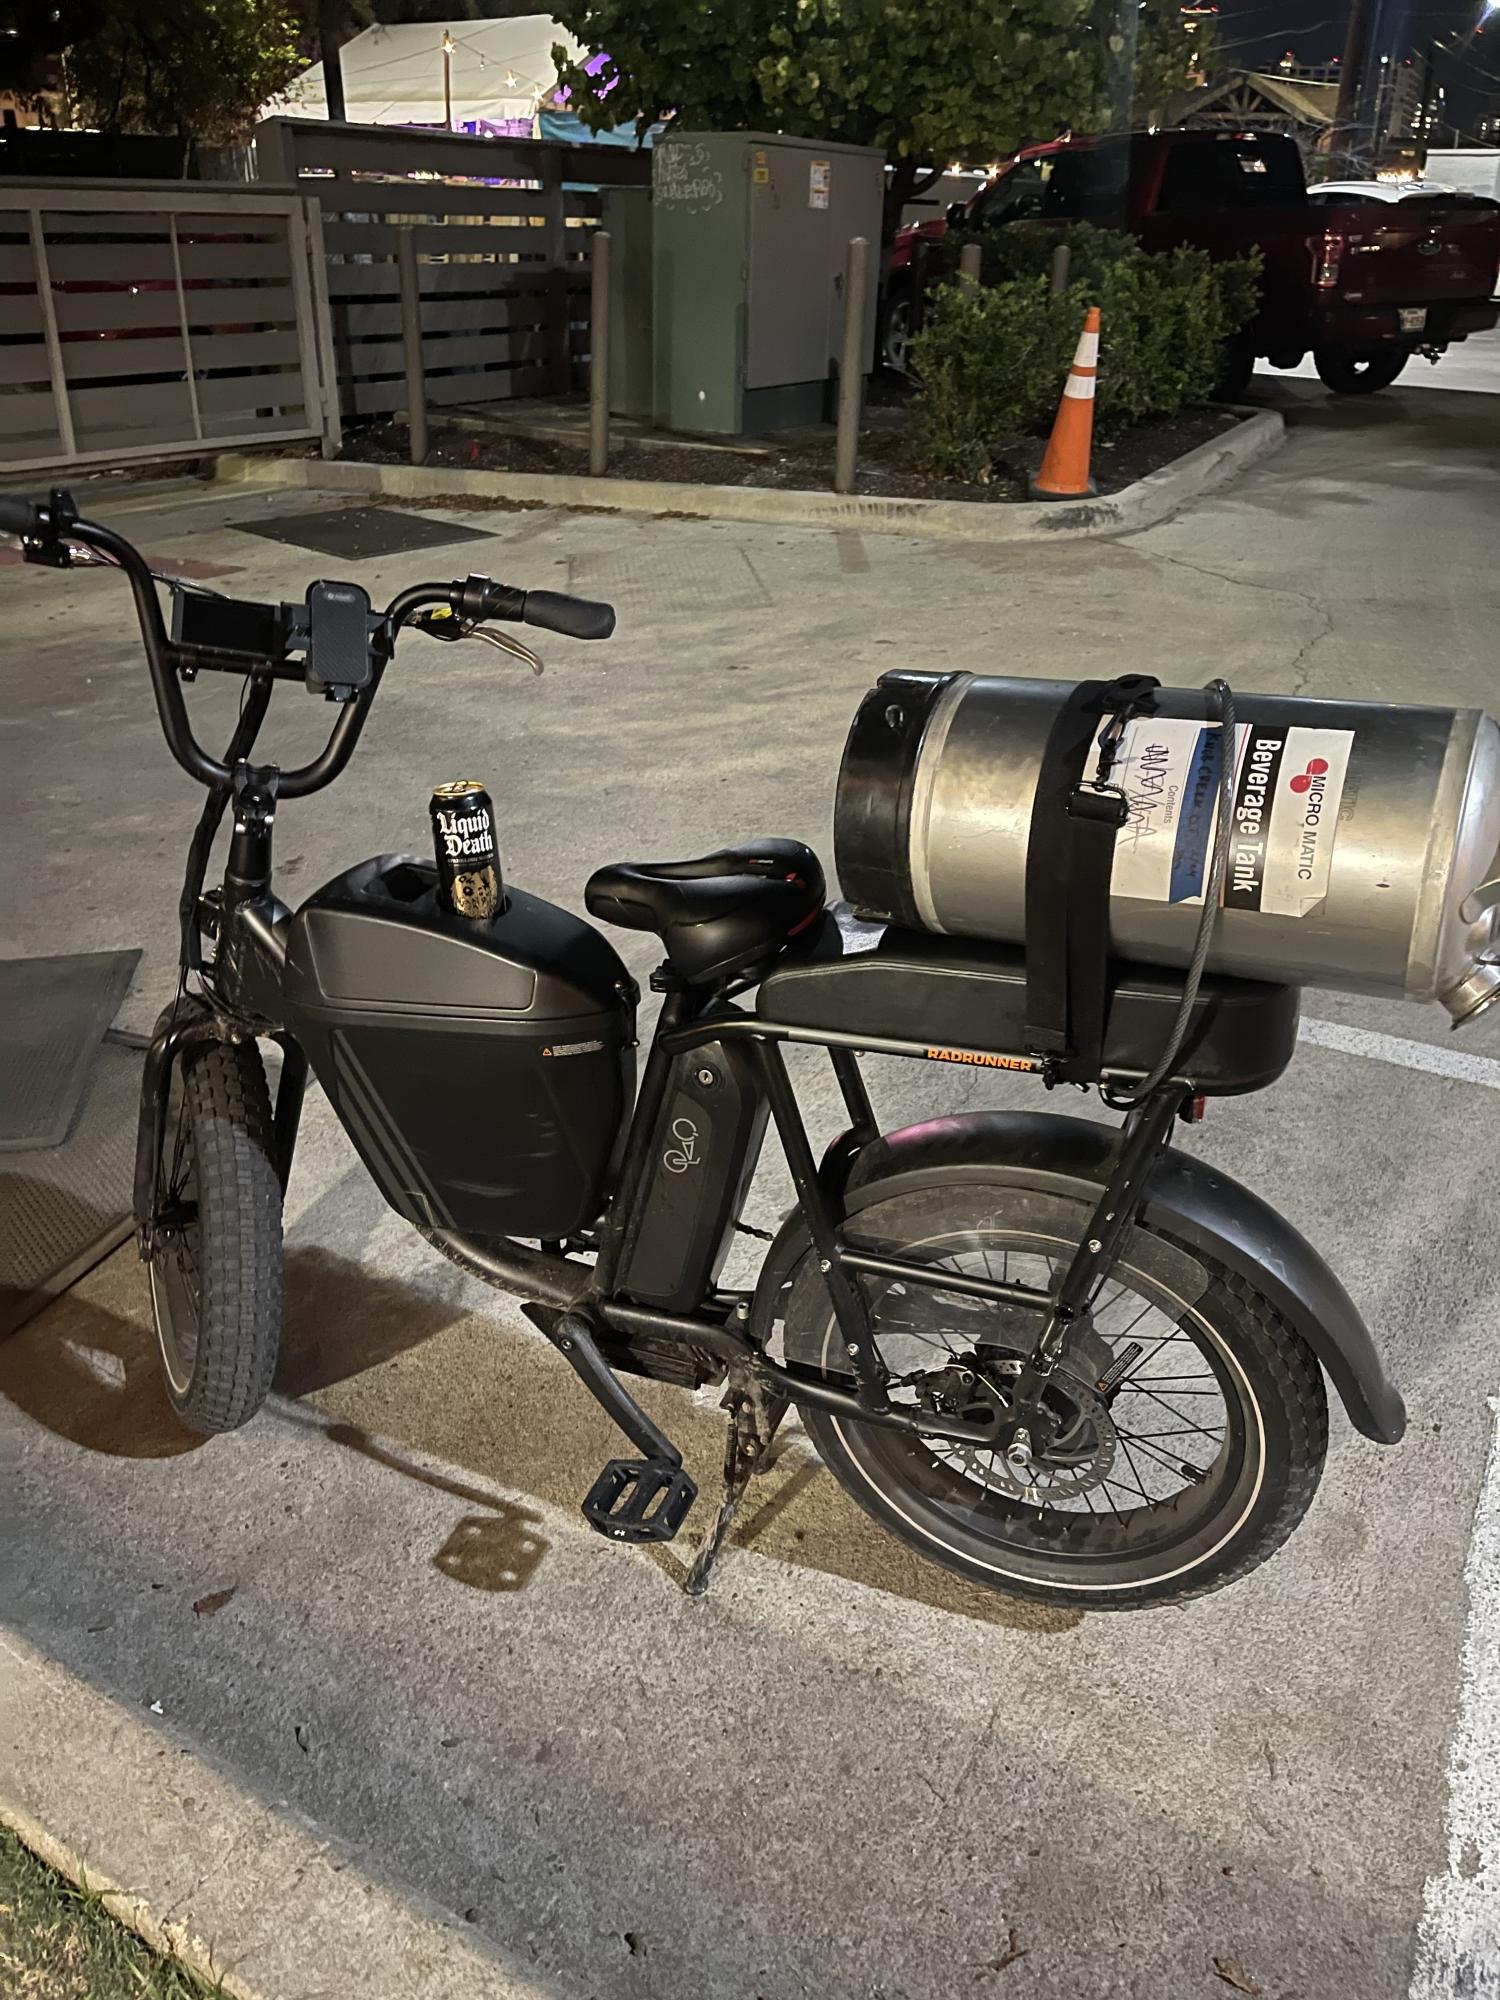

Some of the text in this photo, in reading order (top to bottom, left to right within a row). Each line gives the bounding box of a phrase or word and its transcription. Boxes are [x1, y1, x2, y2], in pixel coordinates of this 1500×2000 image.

[1163, 785, 1179, 824] Contents
[1232, 739, 1283, 893] Beverage Tank
[436, 808, 490, 839] Liquid
[1297, 775, 1327, 881] MICRO MATIC
[443, 829, 494, 857] Death
[927, 1047, 1033, 1071] RADRUNNER
